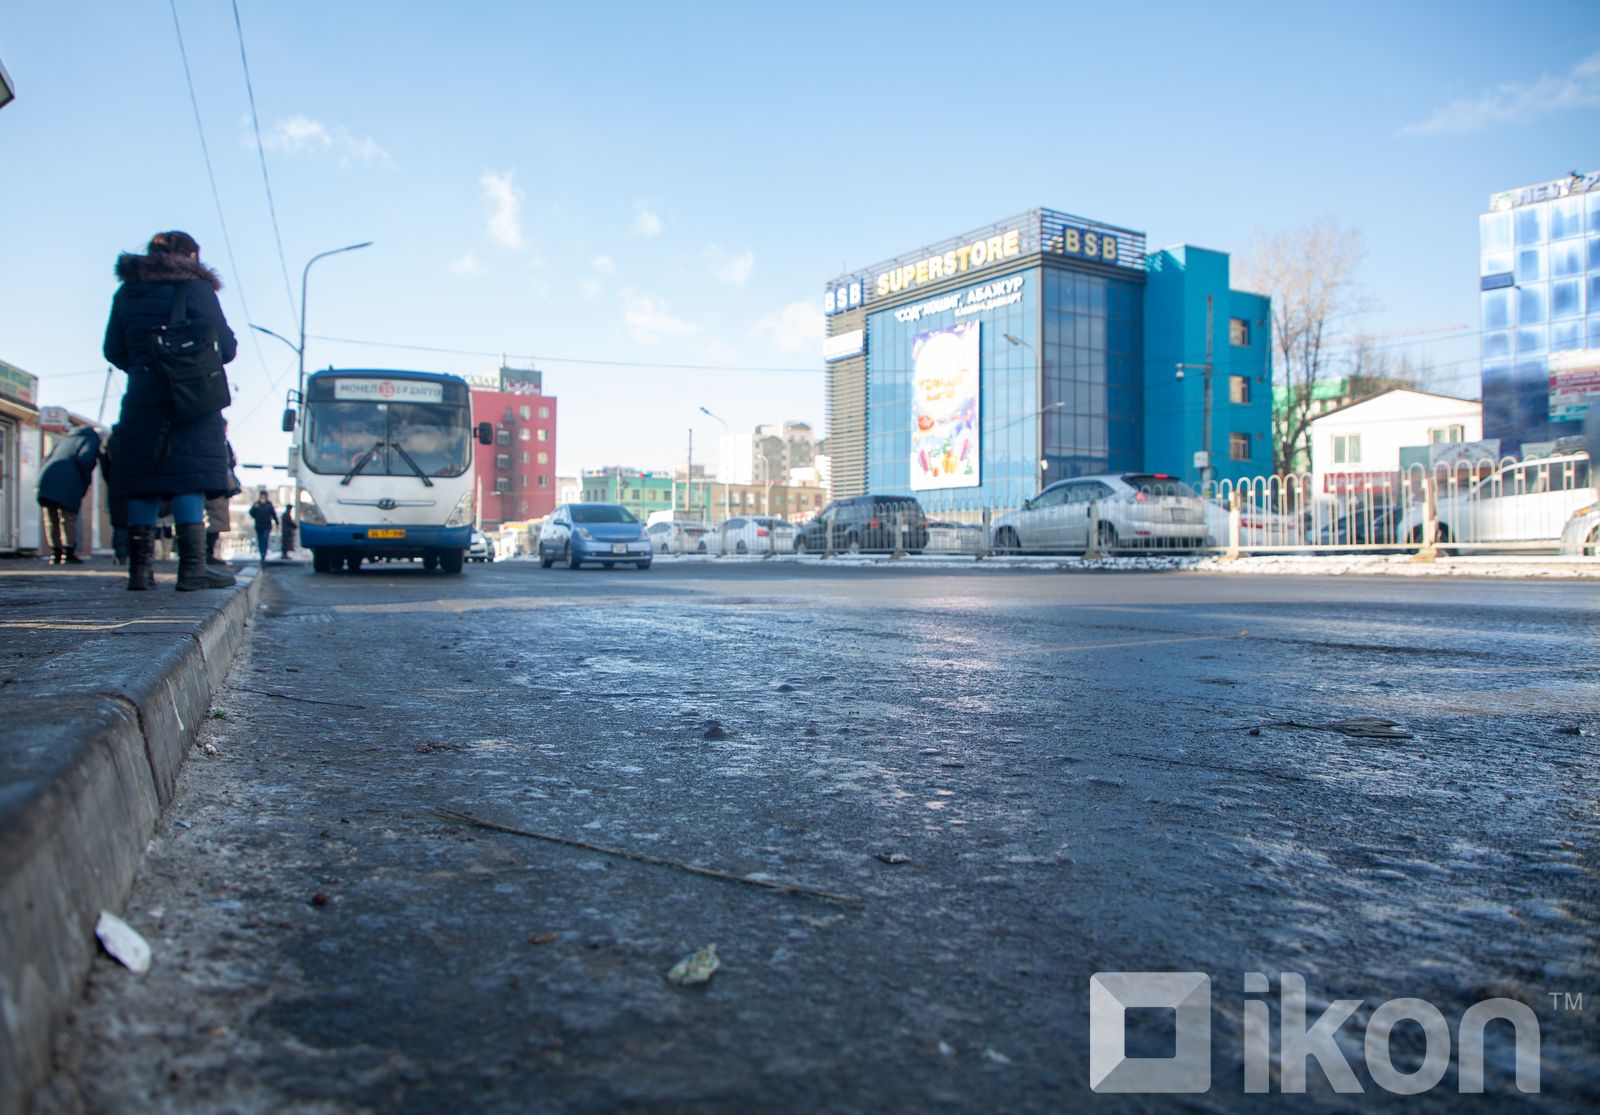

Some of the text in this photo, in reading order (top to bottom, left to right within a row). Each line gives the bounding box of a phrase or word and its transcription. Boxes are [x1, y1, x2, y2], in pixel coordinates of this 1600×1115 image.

[824, 229, 1020, 314] BSB SUPERSTORE
[1065, 228, 1117, 260] BSB
